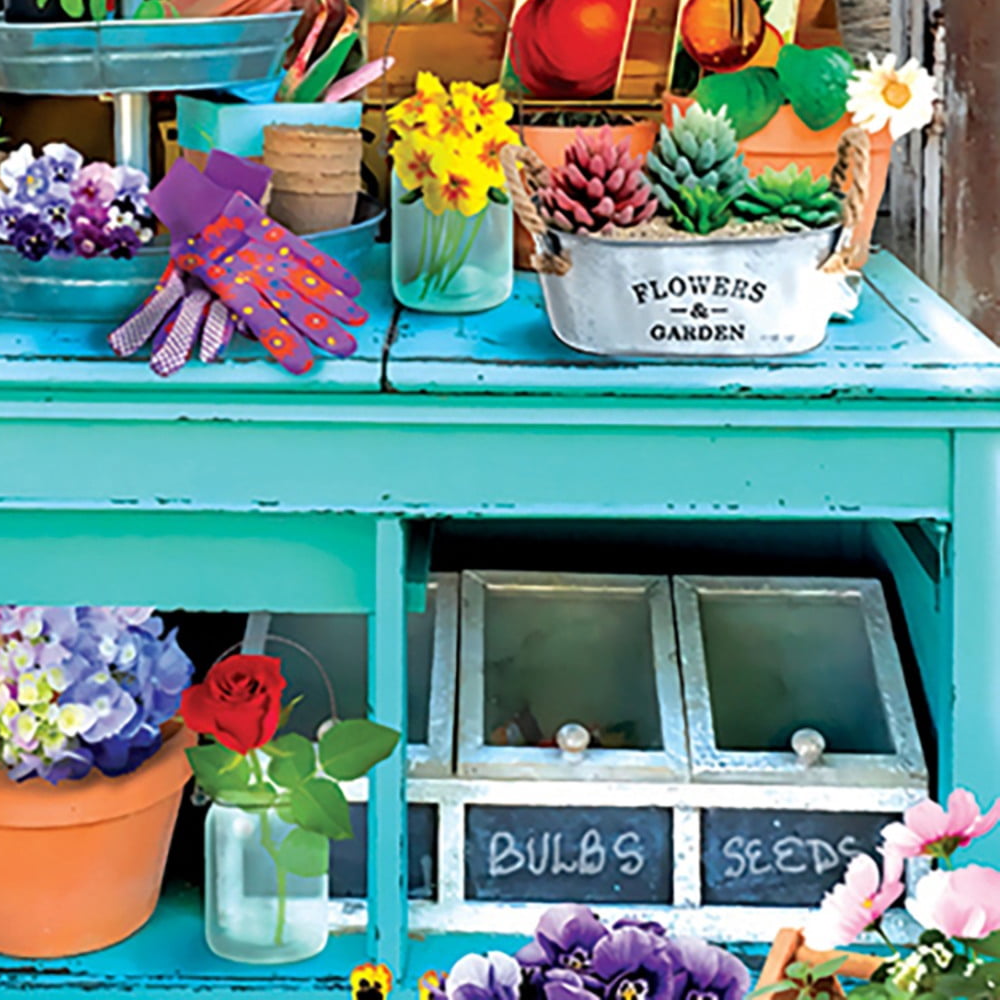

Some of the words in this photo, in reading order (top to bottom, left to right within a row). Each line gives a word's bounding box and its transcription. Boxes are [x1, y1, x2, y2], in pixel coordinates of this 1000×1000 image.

[631, 275, 768, 305] FLOWERS
[689, 302, 710, 320] &
[649, 323, 746, 342] GARDEN
[489, 828, 645, 877] BULBS
[722, 835, 860, 878] SEEDS
